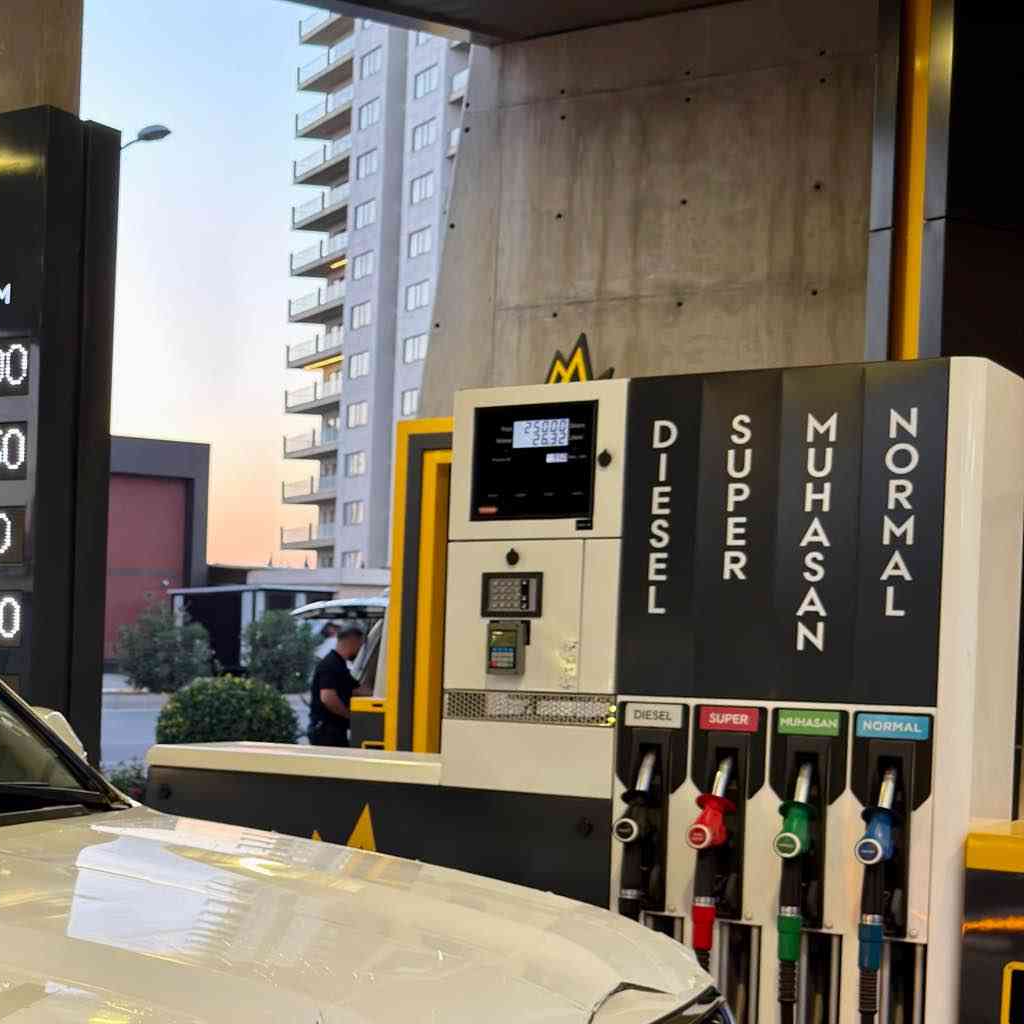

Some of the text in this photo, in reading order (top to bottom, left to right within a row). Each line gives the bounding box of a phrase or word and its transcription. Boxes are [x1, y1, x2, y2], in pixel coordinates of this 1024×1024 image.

[647, 420, 678, 615] DIESEL
[722, 414, 753, 580] SUPER
[796, 412, 838, 651] MUHASAN
[880, 407, 920, 616] NORMAL
[632, 709, 673, 721] DIESEL
[708, 711, 749, 725] SUPER
[779, 716, 838, 729] MUHASAN
[862, 719, 922, 733] NORMAL
